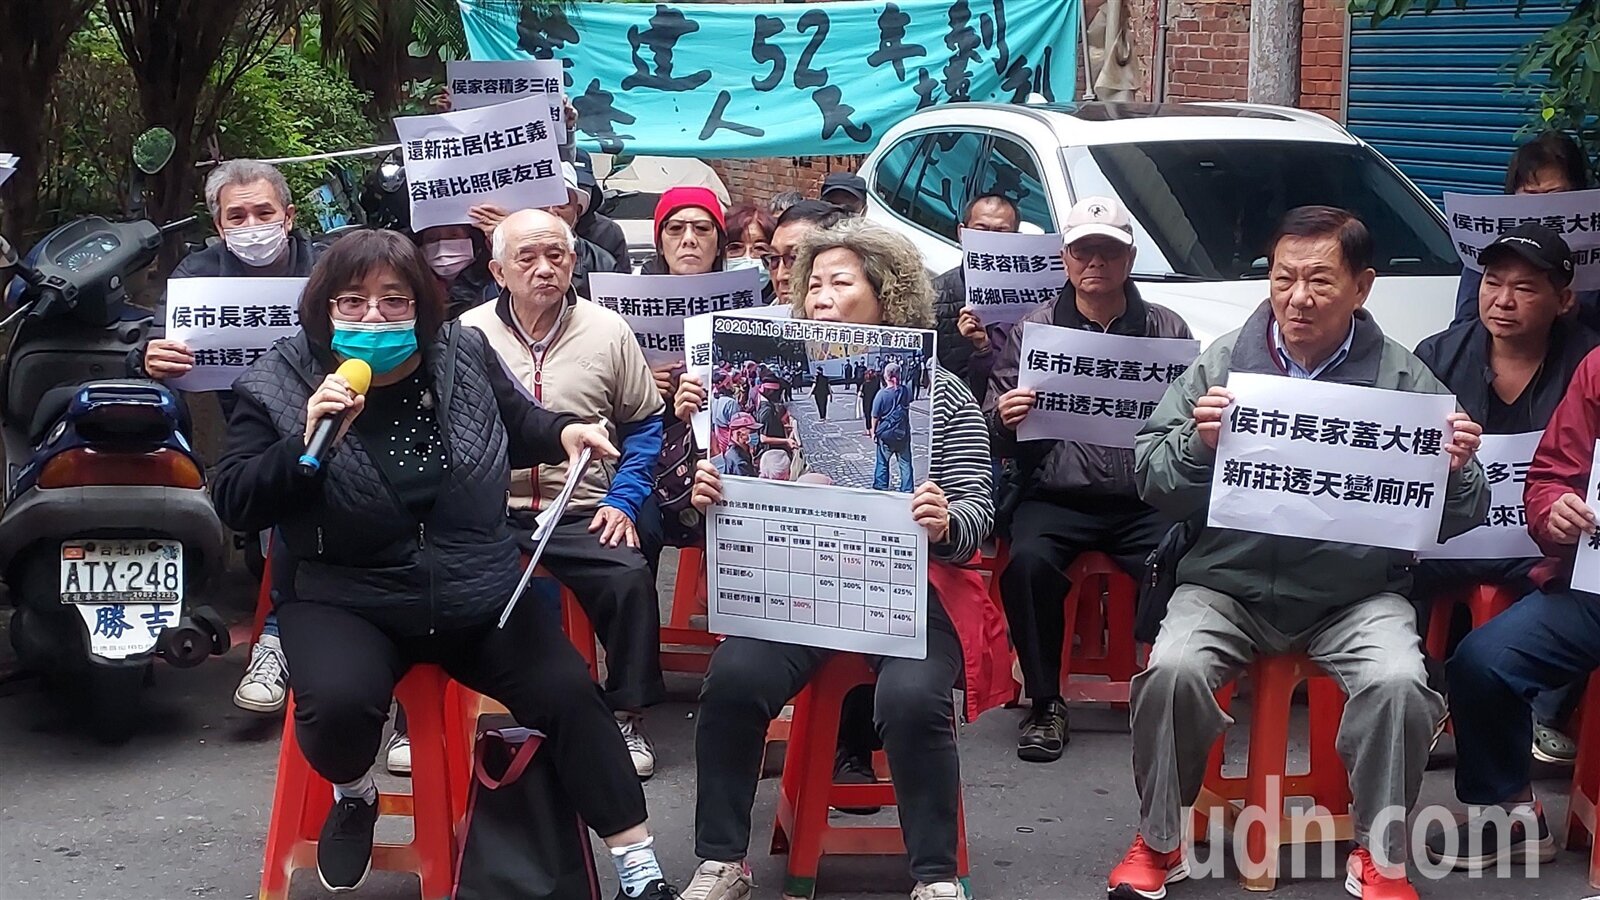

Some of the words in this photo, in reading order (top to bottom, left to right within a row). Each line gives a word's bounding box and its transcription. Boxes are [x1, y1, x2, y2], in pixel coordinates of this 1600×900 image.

[452, 78, 559, 94] 侯家容積多三倍
[407, 120, 548, 161] 還新莊居住正義
[410, 159, 556, 202] 容積比照侯友宜
[967, 251, 1065, 273] 侯家容積多三
[598, 290, 754, 317] 還新莊居住正義
[172, 305, 302, 328] 侯市長家蓋
[714, 319, 780, 337] 2020.11.16
[783, 323, 923, 349] 新北市府前自救會抗議
[1230, 405, 1443, 456] 侯市長家蓋大樓
[1222, 458, 1435, 508] 新莊透天變廁所
[100, 545, 146, 556] 台北市
[820, 554, 834, 562] 50%
[843, 557, 861, 565] 115%
[870, 560, 885, 568] 70%
[869, 610, 885, 618] 70%
